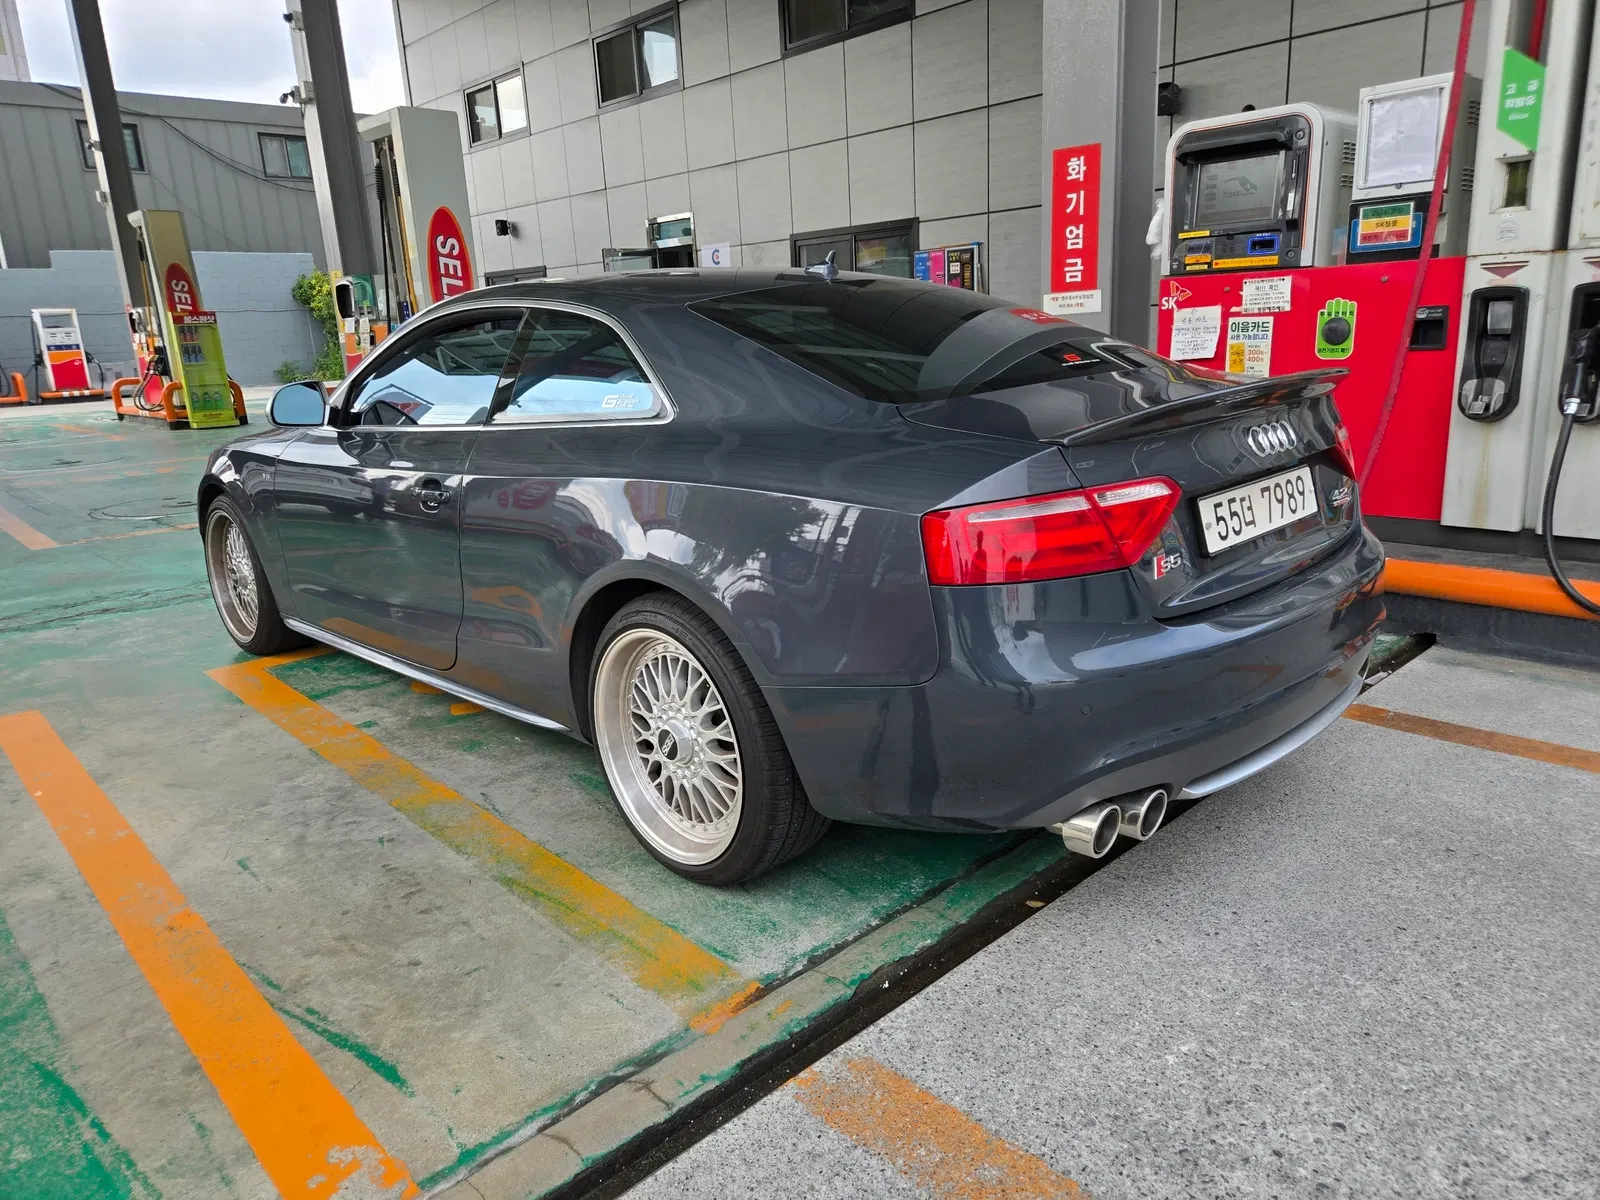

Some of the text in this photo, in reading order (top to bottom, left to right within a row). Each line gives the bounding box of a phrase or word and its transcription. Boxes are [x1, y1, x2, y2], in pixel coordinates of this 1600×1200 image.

[1064, 156, 1087, 283] 화기엄금
[436, 235, 463, 300] SEL
[171, 280, 193, 312] SEL
[1161, 296, 1178, 310] SK
[1230, 321, 1270, 333] 이음카드
[1260, 475, 1306, 523] 7989
[1161, 552, 1182, 573] S5
